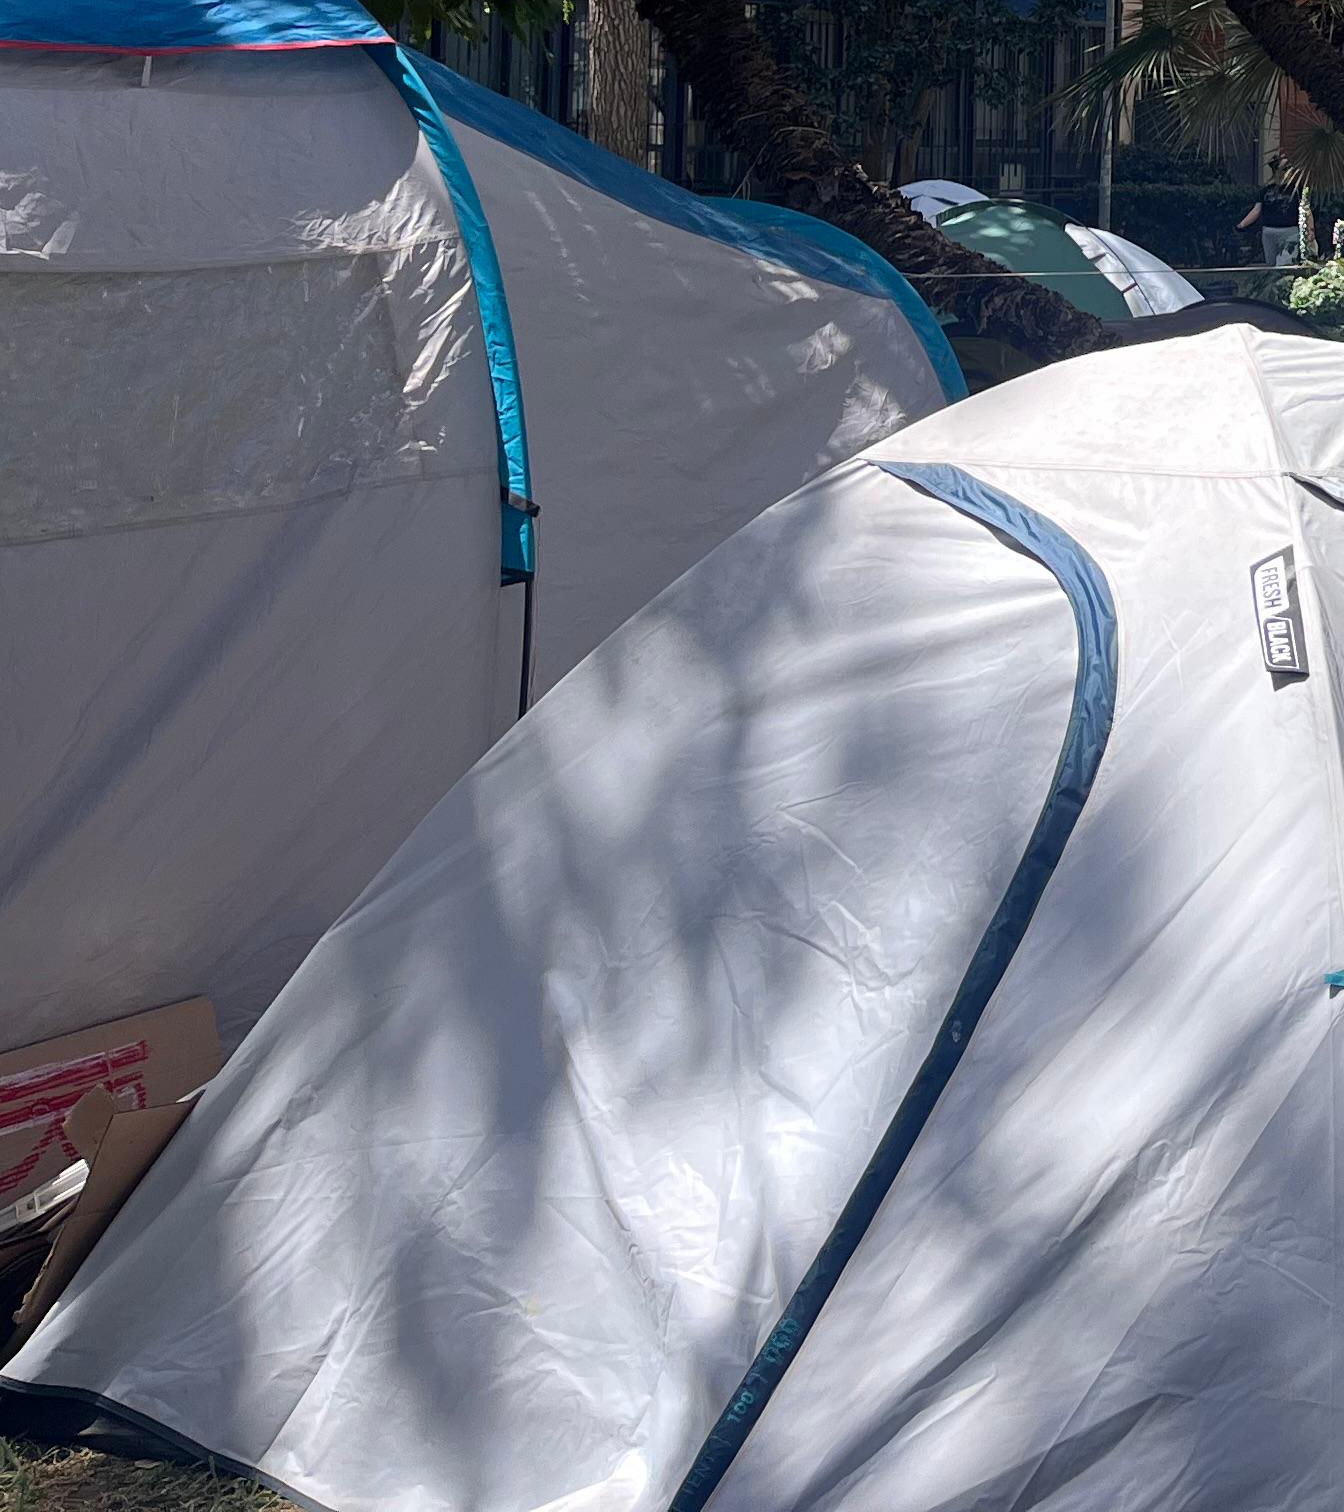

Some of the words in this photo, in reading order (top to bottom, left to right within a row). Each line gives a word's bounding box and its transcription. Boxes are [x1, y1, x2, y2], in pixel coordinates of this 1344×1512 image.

[1260, 566, 1283, 609] FRESH
[1266, 621, 1292, 664] BLACK
[727, 1391, 754, 1422] 100
